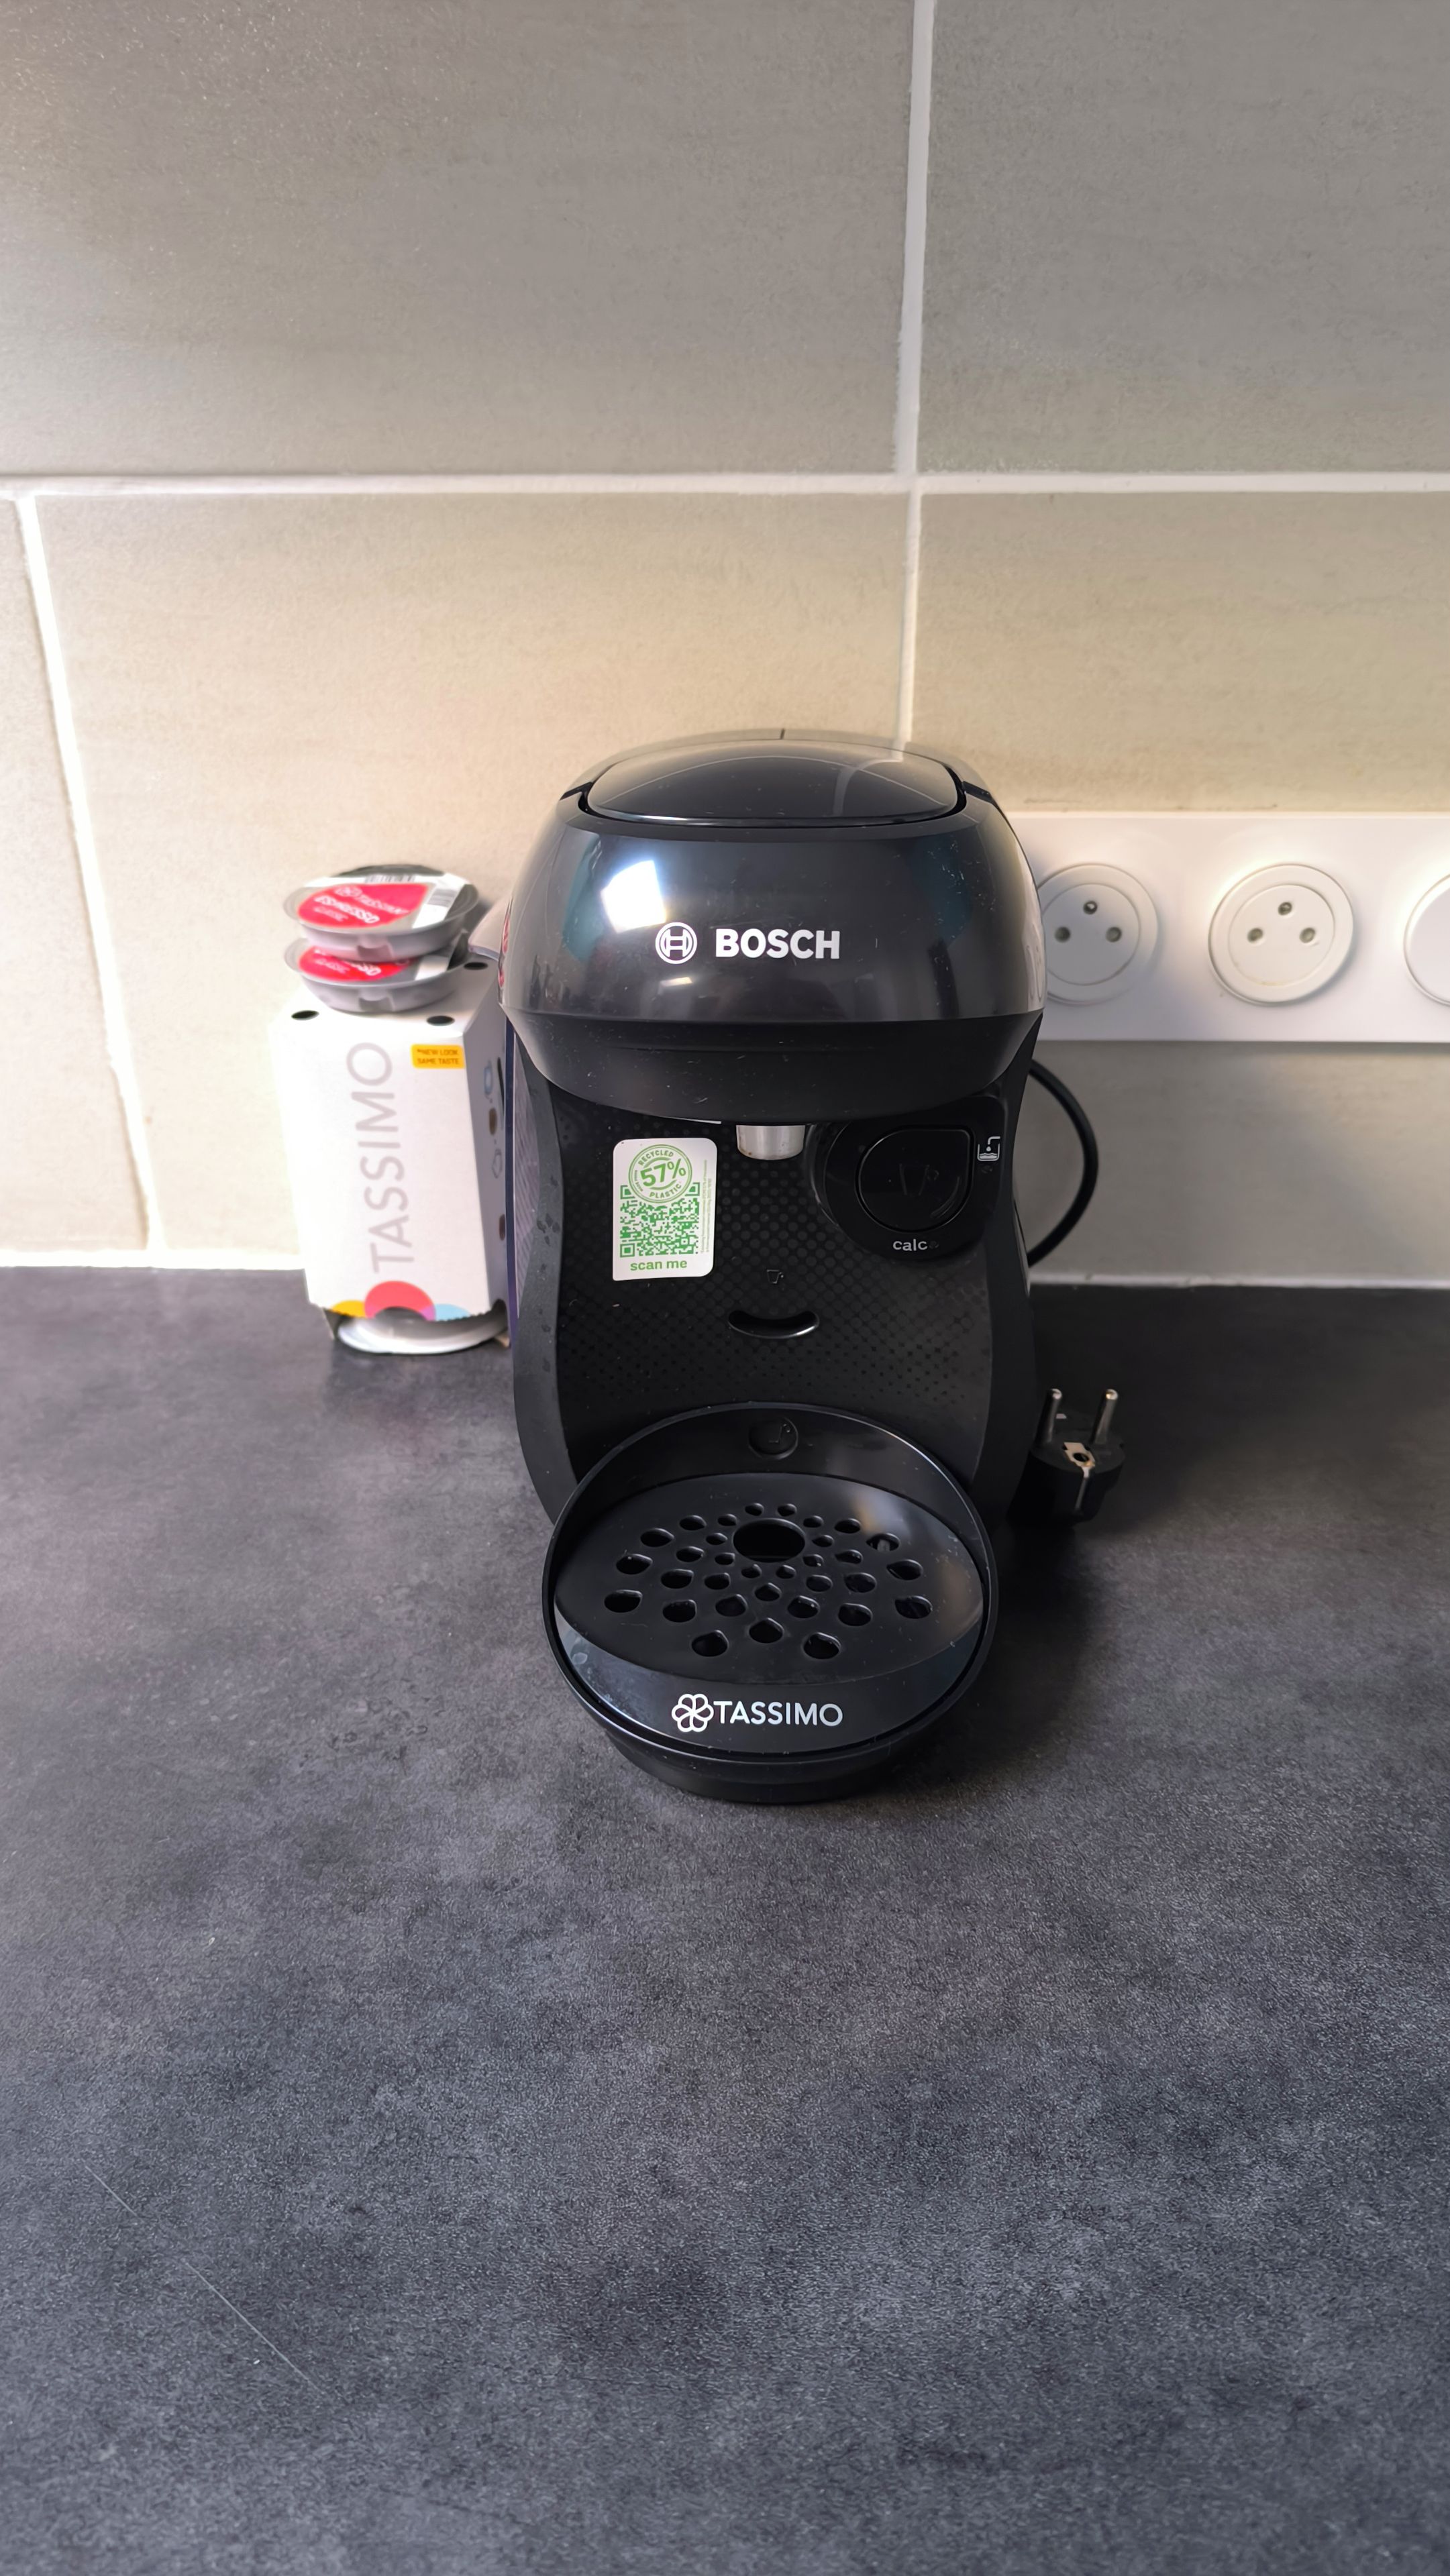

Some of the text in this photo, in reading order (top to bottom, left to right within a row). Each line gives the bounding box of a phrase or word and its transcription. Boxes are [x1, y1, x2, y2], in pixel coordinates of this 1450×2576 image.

[715, 928, 840, 959] BOSCH
[346, 1042, 415, 1274] TASSIMO
[638, 1149, 674, 1166] RECYCLED
[640, 1158, 686, 1187] 57%
[649, 1183, 682, 1199] PLASTIC
[892, 1238, 928, 1252] calc
[630, 1260, 688, 1271] scan me
[713, 1701, 843, 1727] TASSIMO
